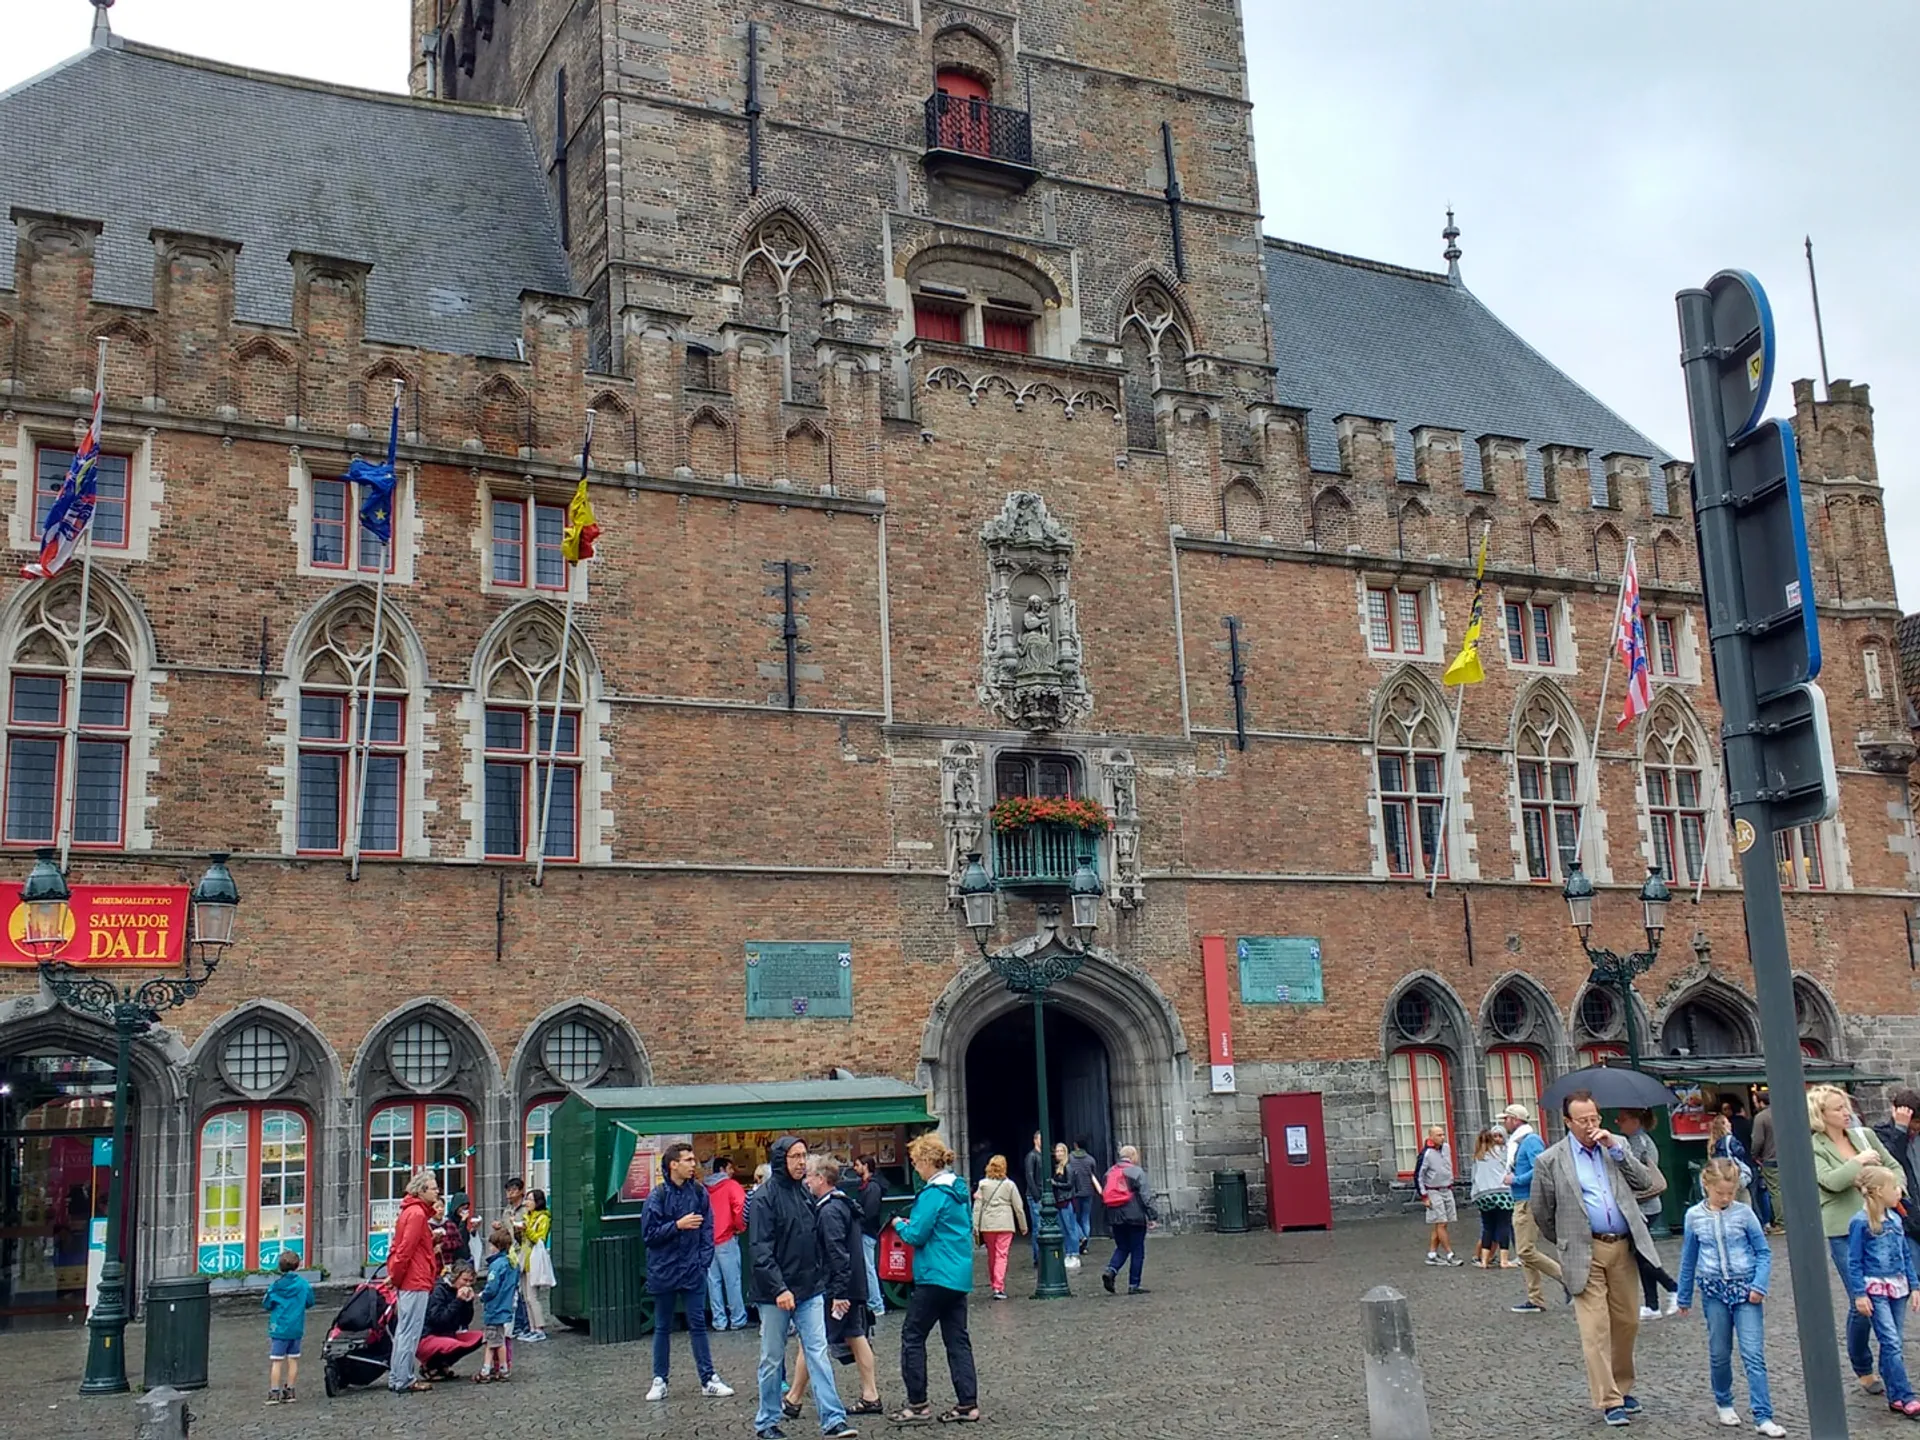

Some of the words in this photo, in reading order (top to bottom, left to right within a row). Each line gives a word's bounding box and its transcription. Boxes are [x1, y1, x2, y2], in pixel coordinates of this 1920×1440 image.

[92, 897, 122, 905] MUSEUM
[123, 897, 155, 905] GALLERY
[89, 914, 169, 928] SALVADOR
[88, 929, 168, 958] DALI
